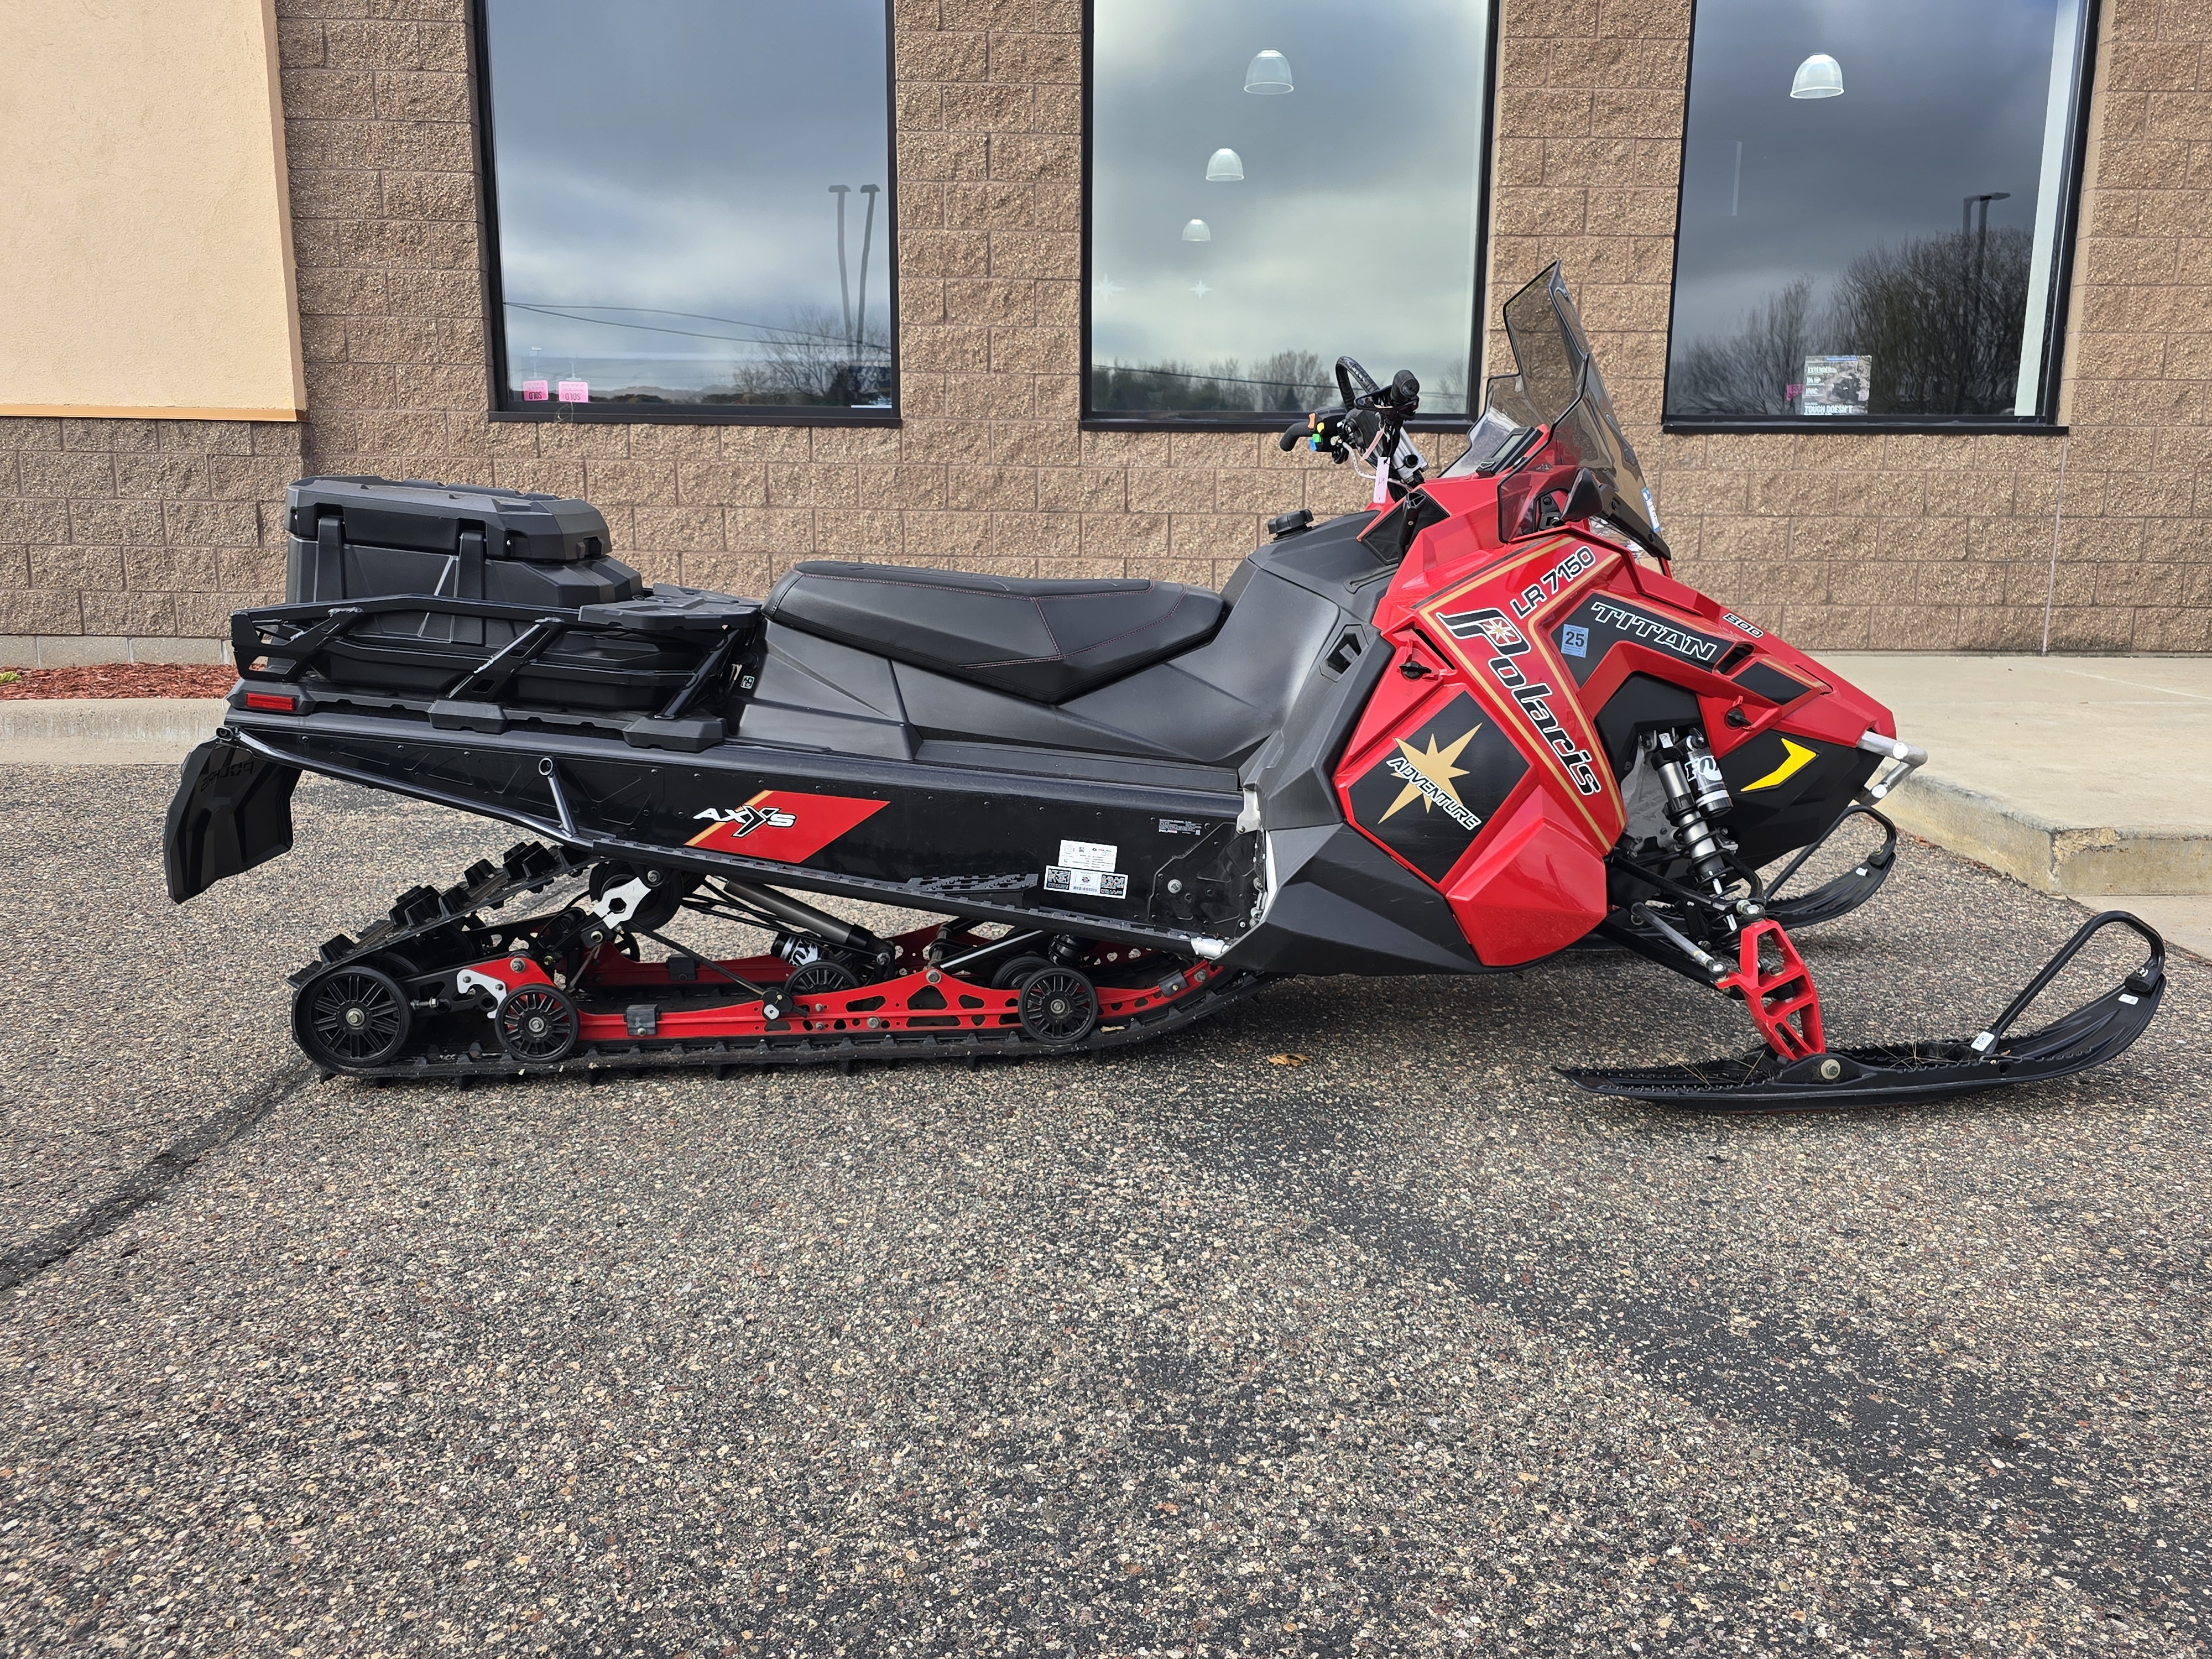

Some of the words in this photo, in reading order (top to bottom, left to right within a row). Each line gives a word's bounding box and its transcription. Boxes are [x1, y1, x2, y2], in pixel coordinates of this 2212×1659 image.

[1804, 405, 1825, 414] TOUGH
[1826, 404, 1853, 414] DOESN'T
[1510, 583, 1547, 619] LR
[1540, 546, 1596, 594] 7150
[1565, 632, 1584, 647] 25
[1591, 602, 1717, 660] TITAN
[1722, 613, 1764, 638] 800
[1436, 607, 1601, 795] Polaris
[1386, 757, 1481, 831] ADVENTURE
[693, 805, 796, 837] AXYS
